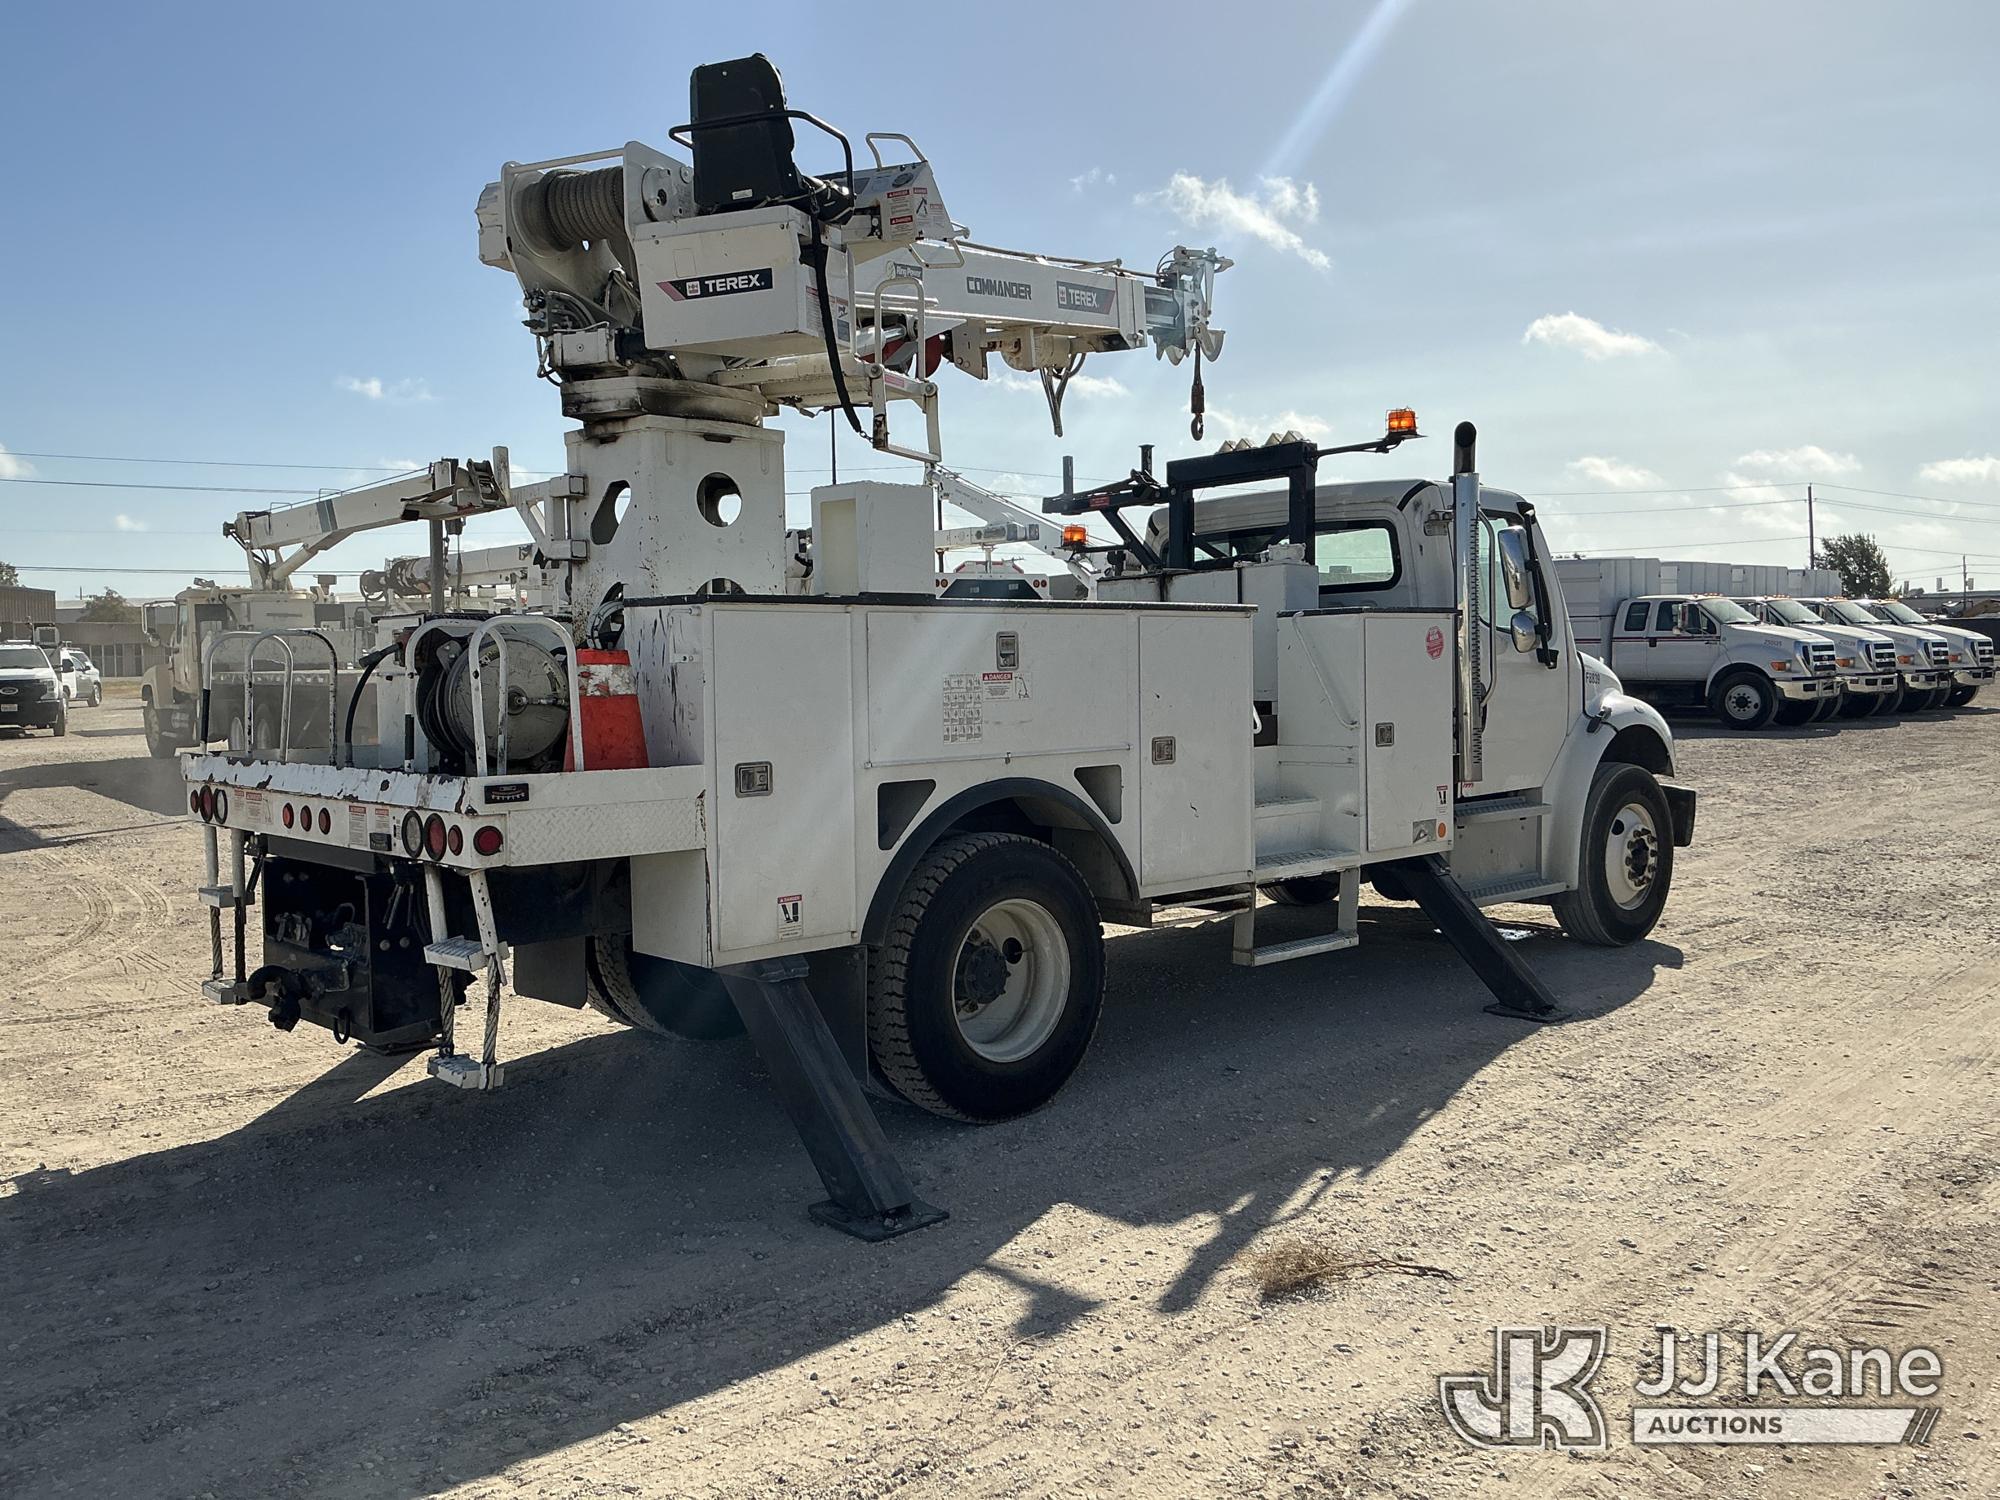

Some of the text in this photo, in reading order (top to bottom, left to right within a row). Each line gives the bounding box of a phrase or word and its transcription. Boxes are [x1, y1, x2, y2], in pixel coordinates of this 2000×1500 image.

[704, 273, 761, 293] TEREX
[966, 276, 1032, 300] COMMANDER
[1068, 288, 1098, 308] TEREX
